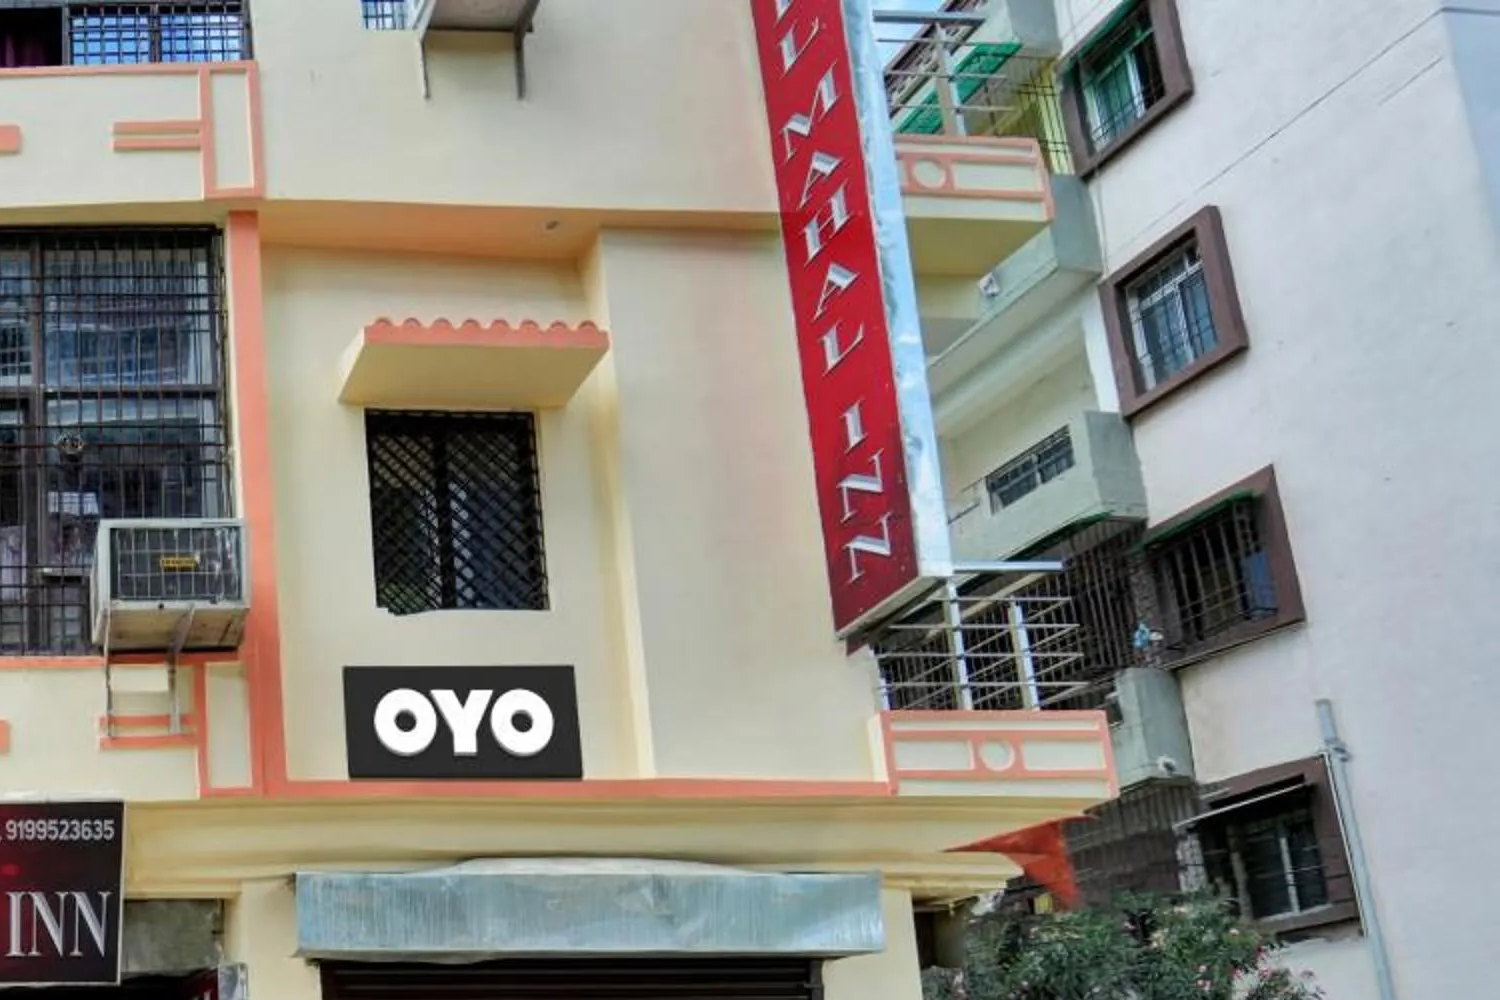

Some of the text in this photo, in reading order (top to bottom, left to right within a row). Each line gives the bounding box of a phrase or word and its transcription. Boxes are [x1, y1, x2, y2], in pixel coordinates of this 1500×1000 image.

[780, 57, 864, 377] MAHAL
[837, 396, 893, 584] INN
[373, 688, 555, 757] OYO
[5, 818, 116, 841] 9199523635
[5, 891, 113, 958] INN
